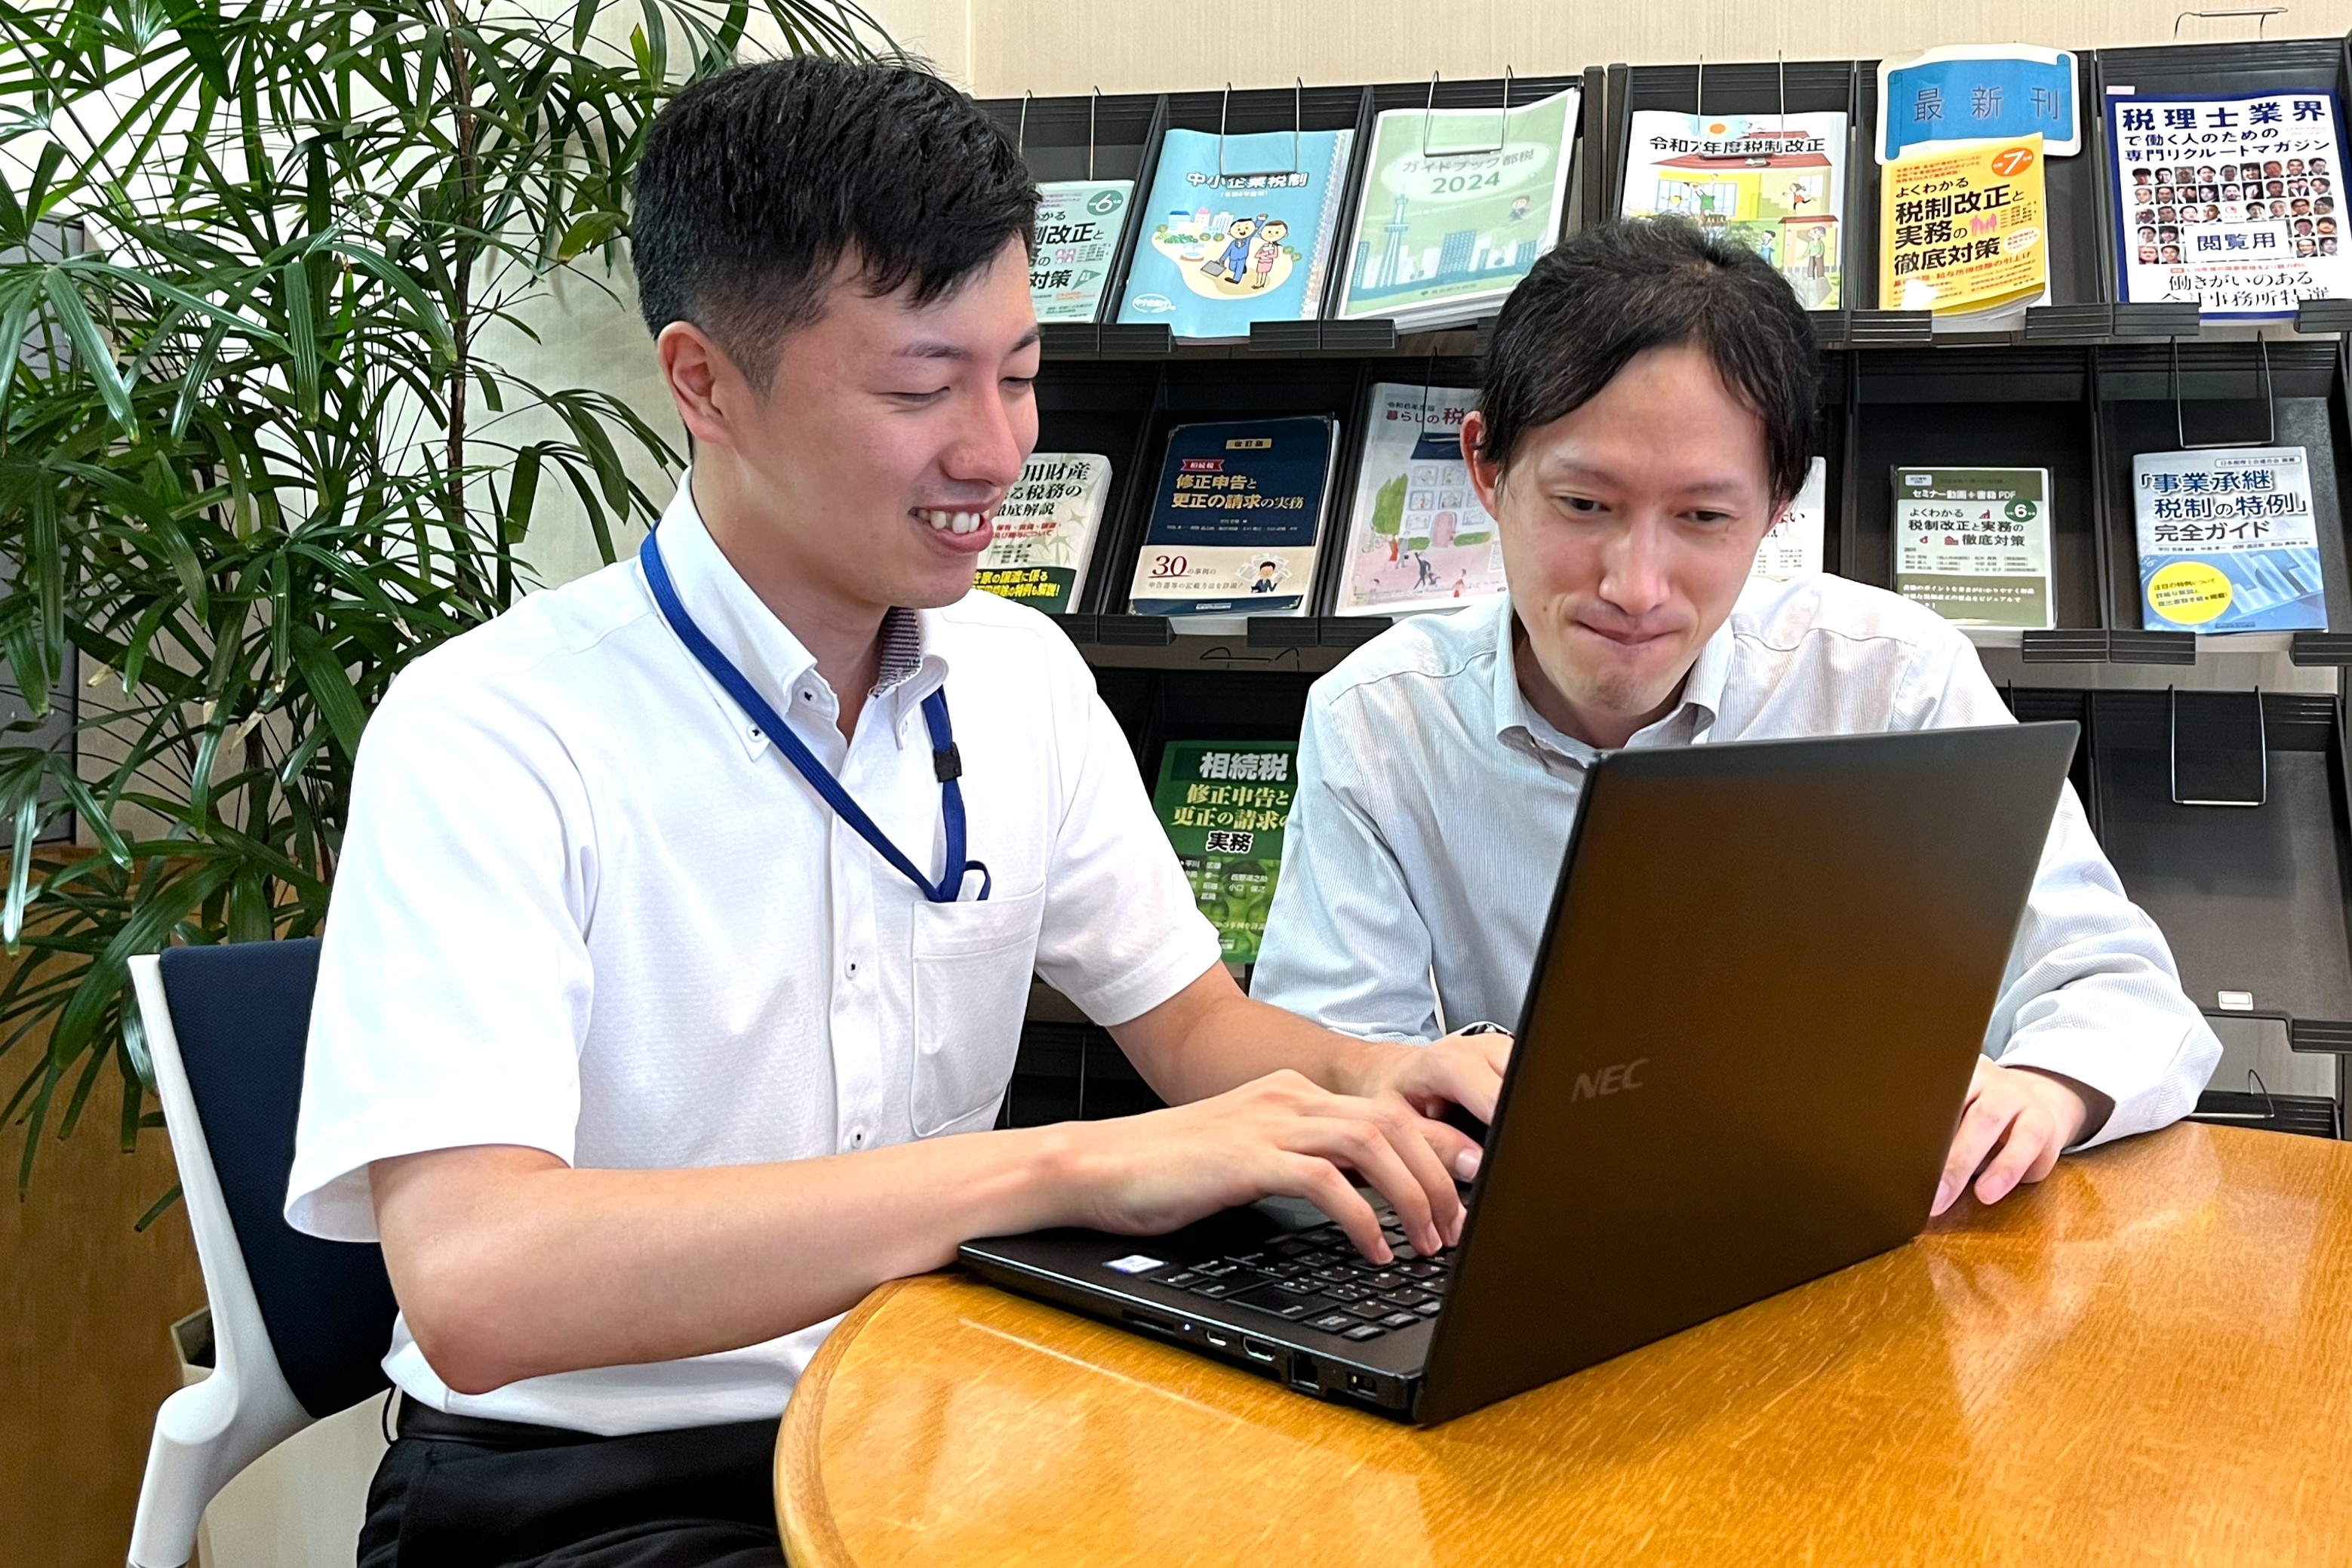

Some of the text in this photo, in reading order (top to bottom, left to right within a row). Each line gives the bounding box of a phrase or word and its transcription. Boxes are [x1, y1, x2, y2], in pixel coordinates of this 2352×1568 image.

[1914, 85, 2058, 121] 最新刊
[2123, 100, 2326, 131] 税理士業界
[1649, 137, 1825, 155] 令和7年度税制改正
[2125, 128, 2279, 146] で働く人のための
[2125, 139, 2329, 161] 専門リクルートマガジン
[1186, 172, 1309, 189] 中小企業税制
[1431, 171, 1501, 194] 2024
[1895, 177, 1969, 198] よくわかる
[1895, 184, 2025, 225] 税制改正と
[1895, 220, 1968, 250] 実務の
[2197, 232, 2276, 251] 閲覧用
[1894, 237, 2000, 276] 徹底対策
[2169, 271, 2313, 291] 働きがいのある
[1176, 474, 1257, 490] 修正申告と
[2141, 469, 2272, 493] 「事業承継
[1171, 493, 1305, 509] 更正の請求の実務
[2154, 493, 2307, 518] 税制の特例」
[1909, 508, 1963, 518] よくわかる
[1908, 519, 2024, 533] 税制改正と実務の
[2154, 521, 2270, 542] 完全ガイド
[1962, 533, 2025, 547] 徹底対策
[1199, 752, 1289, 782] 相続税
[1186, 784, 1289, 807] 修正申告と
[1207, 832, 1252, 853] 実務
[1570, 1057, 1650, 1104] NEC
